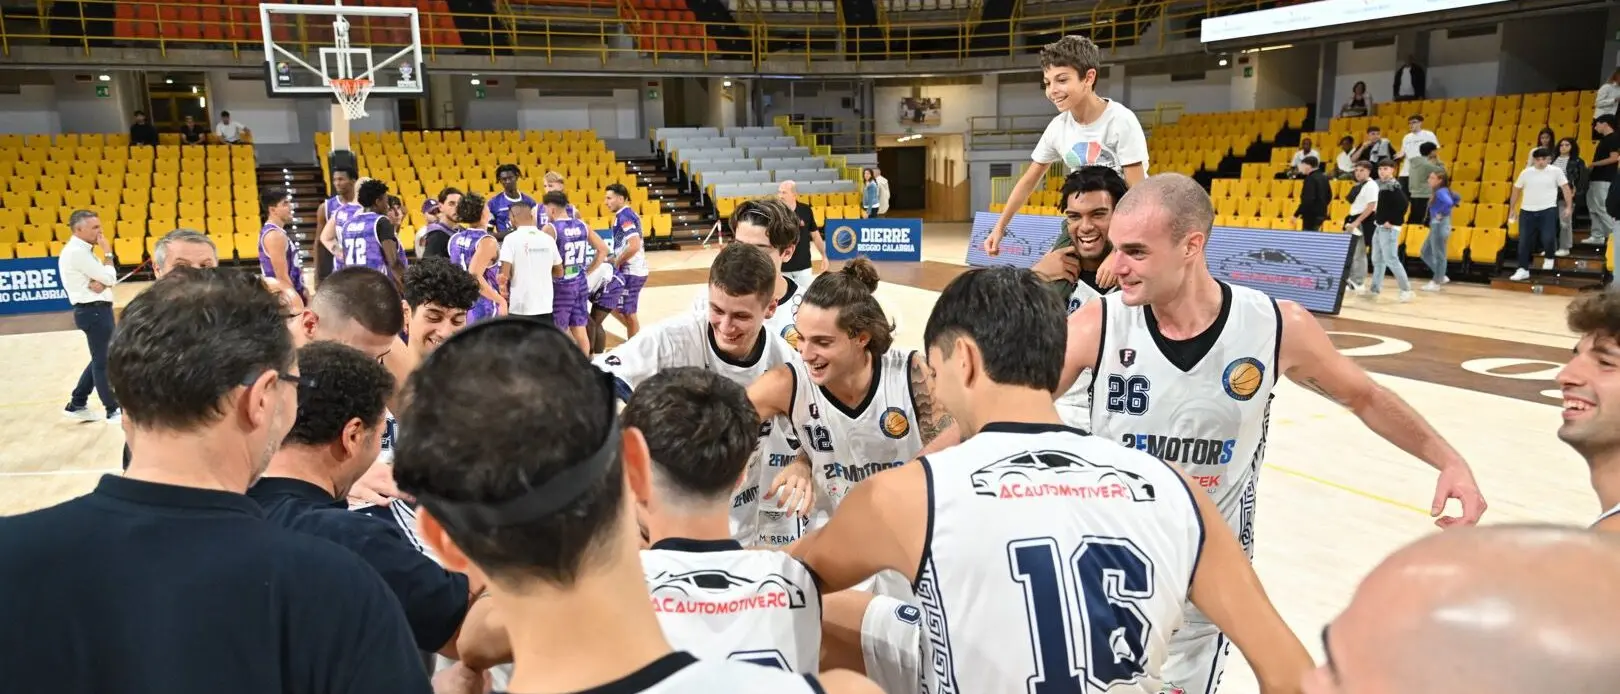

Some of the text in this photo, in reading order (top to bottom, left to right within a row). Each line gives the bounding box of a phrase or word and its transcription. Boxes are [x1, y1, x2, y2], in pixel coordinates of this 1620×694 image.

[858, 244, 915, 253] REGGIO CALABRIA
[861, 228, 911, 243] DIERRE
[344, 237, 367, 266] 72
[564, 240, 586, 265] 27
[12, 289, 69, 302] CALABRIA
[1107, 374, 1150, 416] 26
[802, 424, 834, 453] 12
[1122, 433, 1236, 466] 2FMOTORS
[759, 534, 796, 544] MRENA
[1006, 535, 1155, 694] 16
